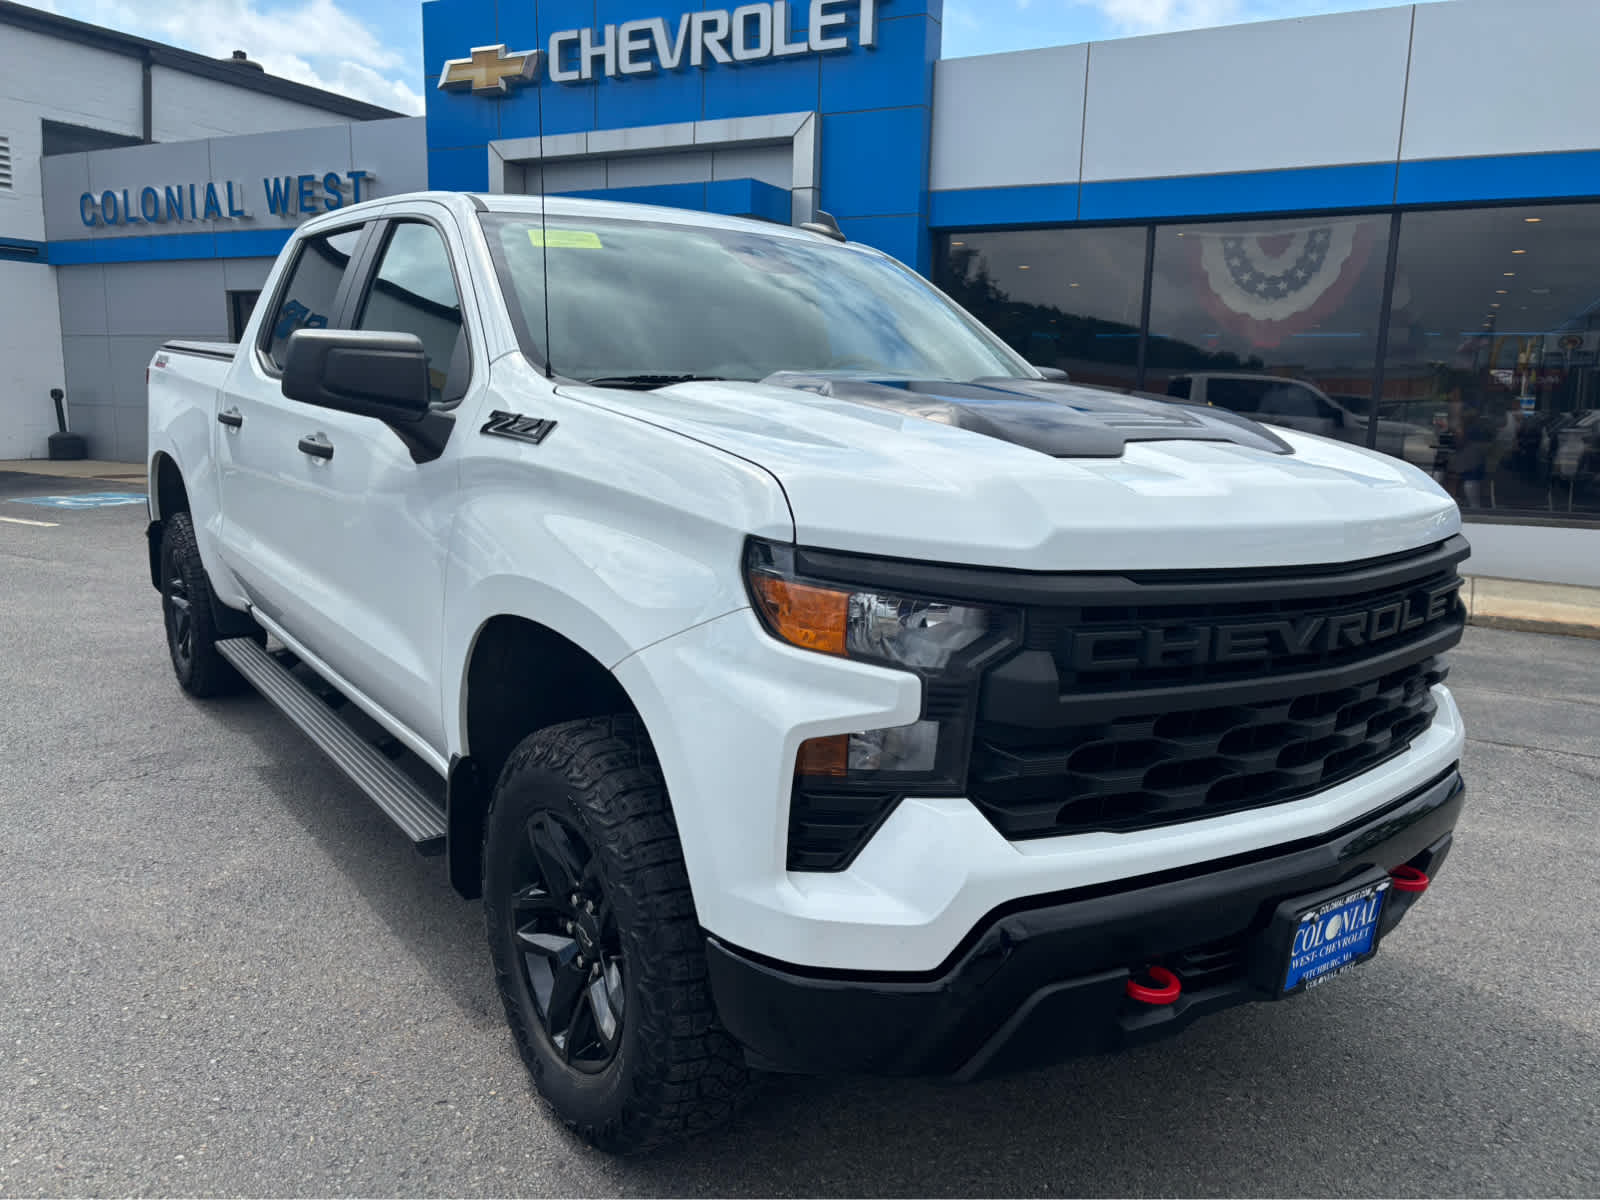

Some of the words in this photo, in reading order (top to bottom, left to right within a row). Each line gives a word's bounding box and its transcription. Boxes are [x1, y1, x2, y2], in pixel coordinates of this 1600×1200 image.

[547, 0, 880, 83] CHEVROLET
[80, 181, 245, 227] COLONIAL
[263, 171, 368, 215] WEST
